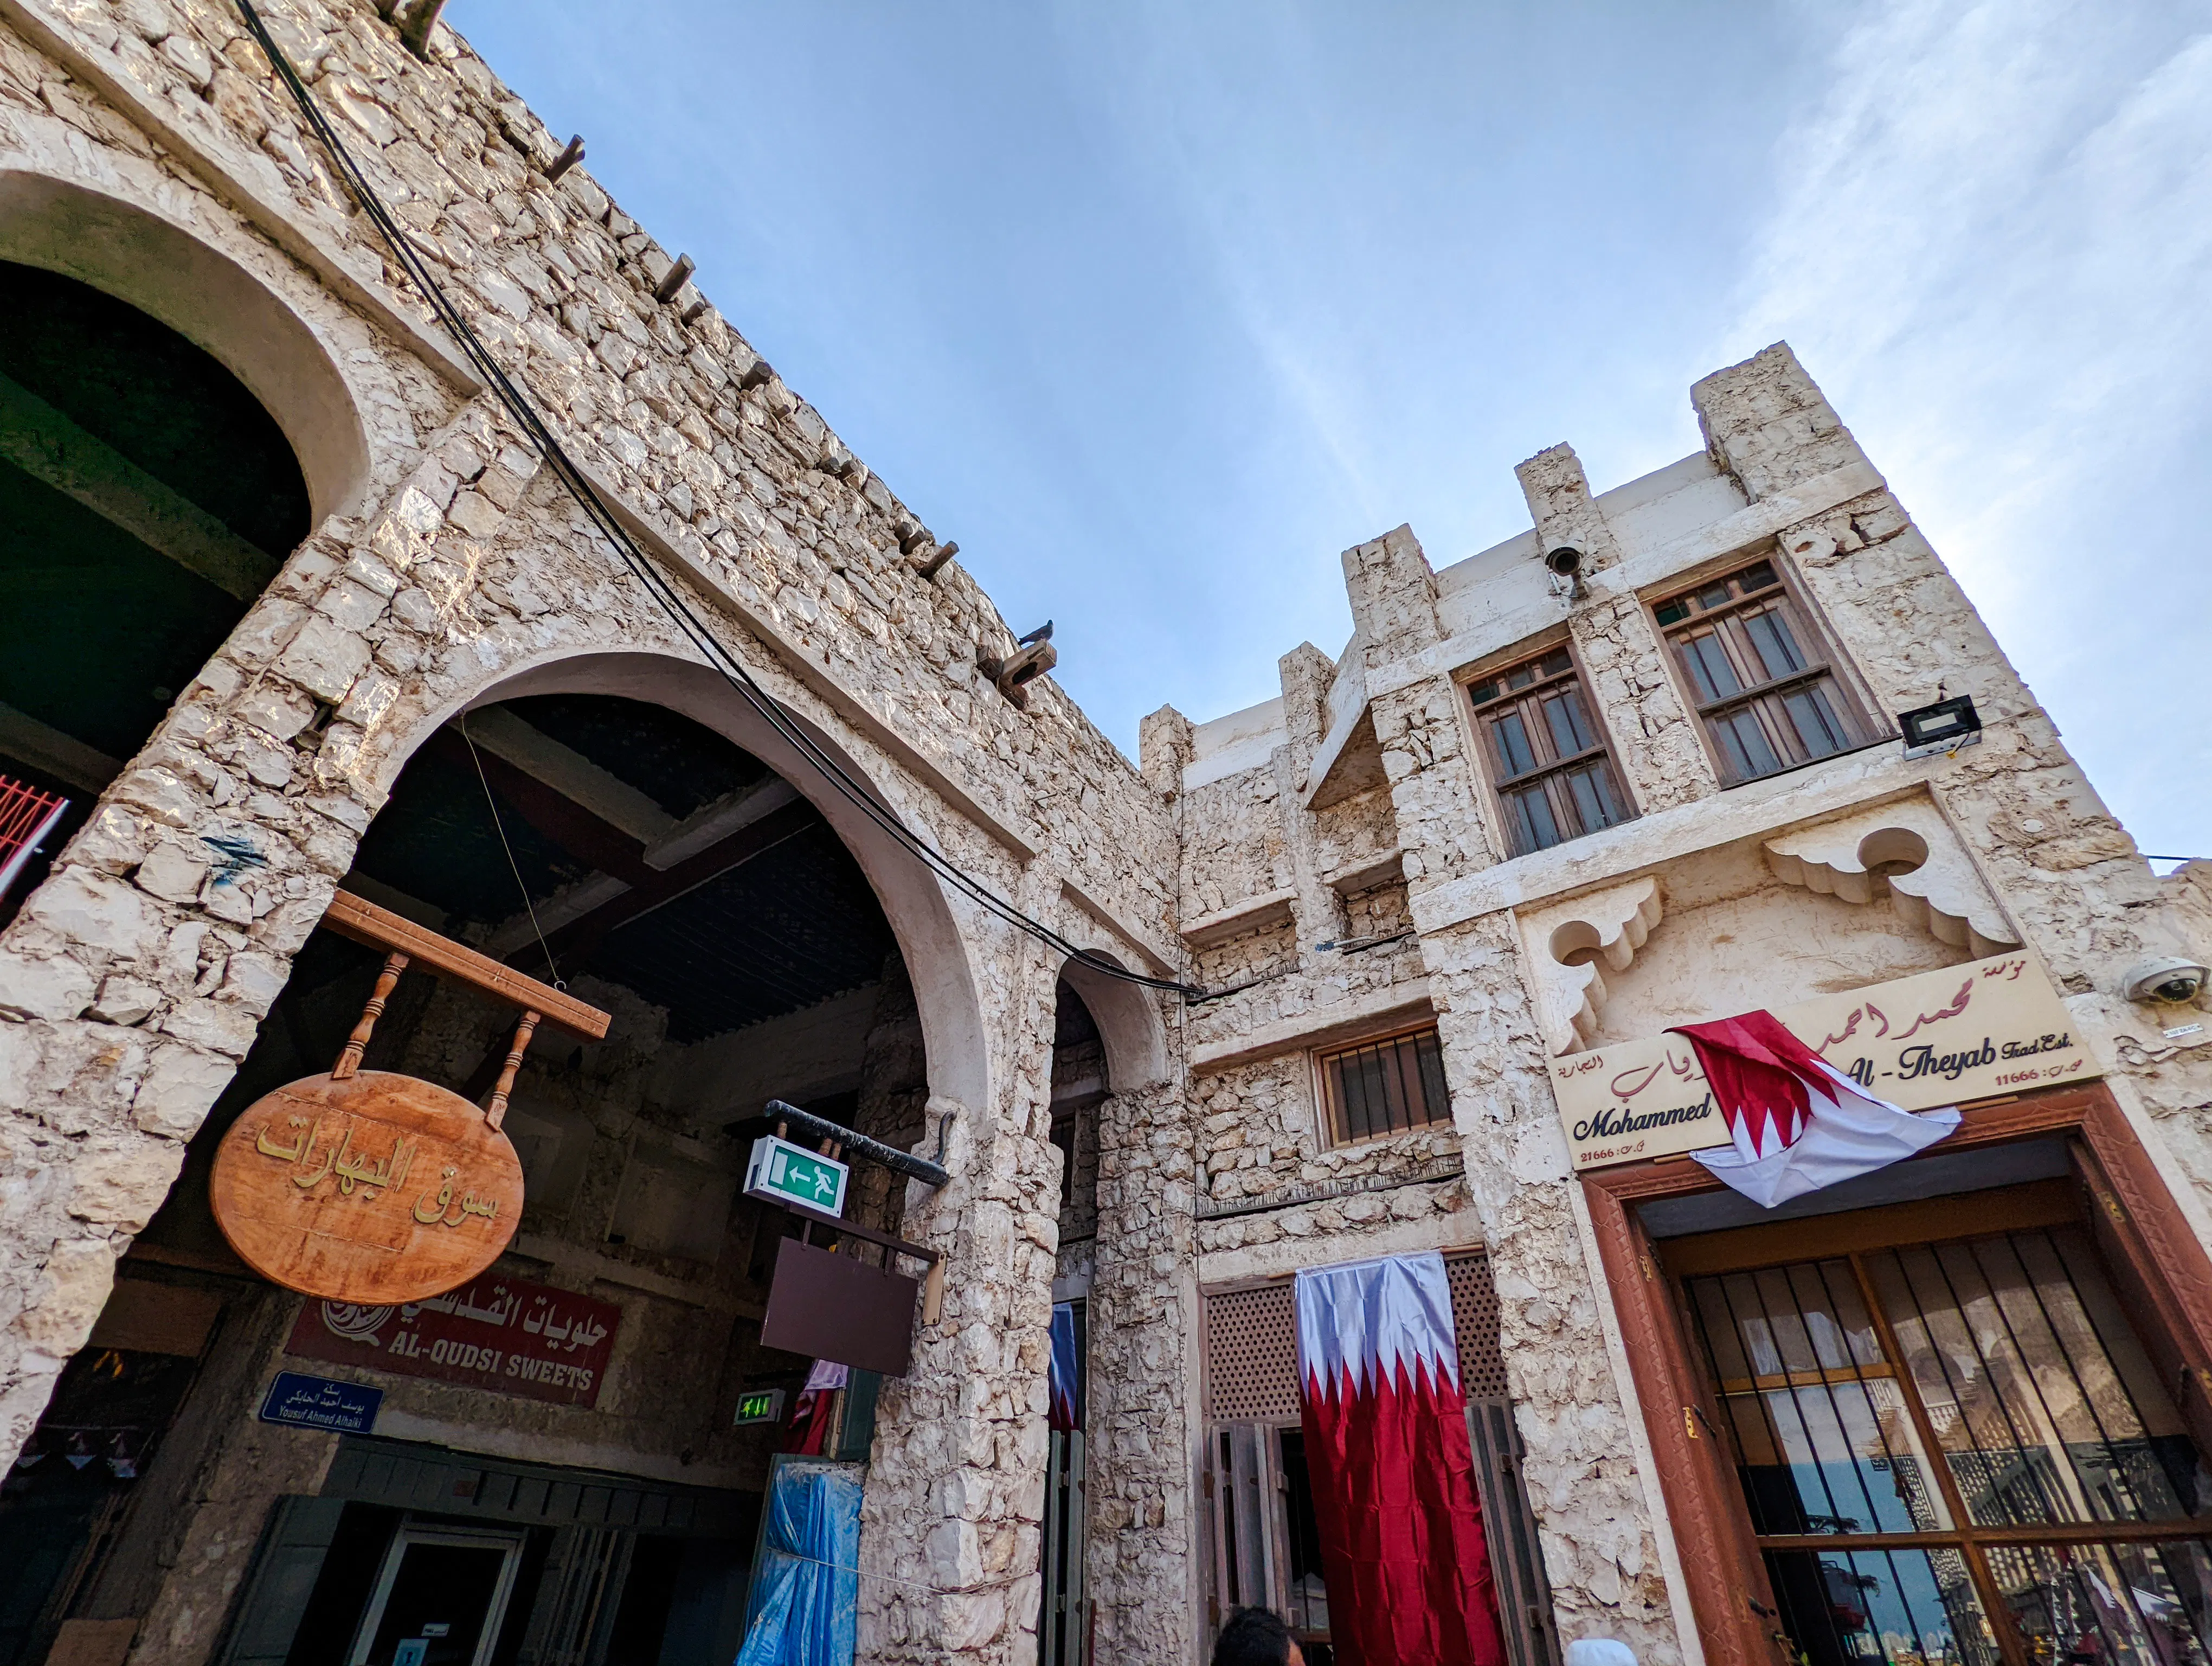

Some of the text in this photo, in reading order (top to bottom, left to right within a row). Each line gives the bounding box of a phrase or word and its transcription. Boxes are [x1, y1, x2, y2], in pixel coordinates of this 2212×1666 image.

[1891, 977, 1973, 1040] محمد
[1558, 1055, 1603, 1078] التجارية
[1995, 1068, 2040, 1086] 11666
[1573, 1093, 1712, 1141] Mohammed
[1898, 1037, 1997, 1081] Theyab
[256, 1115, 500, 1227] سوق البهارات
[1581, 1149, 1615, 1163] 21666
[400, 1284, 523, 1328] القدسي
[523, 1295, 608, 1353] حلويات
[390, 1330, 594, 1391] AL-QUDSI SWEETS
[279, 1405, 307, 1420] Yousuf
[307, 1410, 335, 1424] Ahmed
[342, 1400, 364, 1414] يوسف
